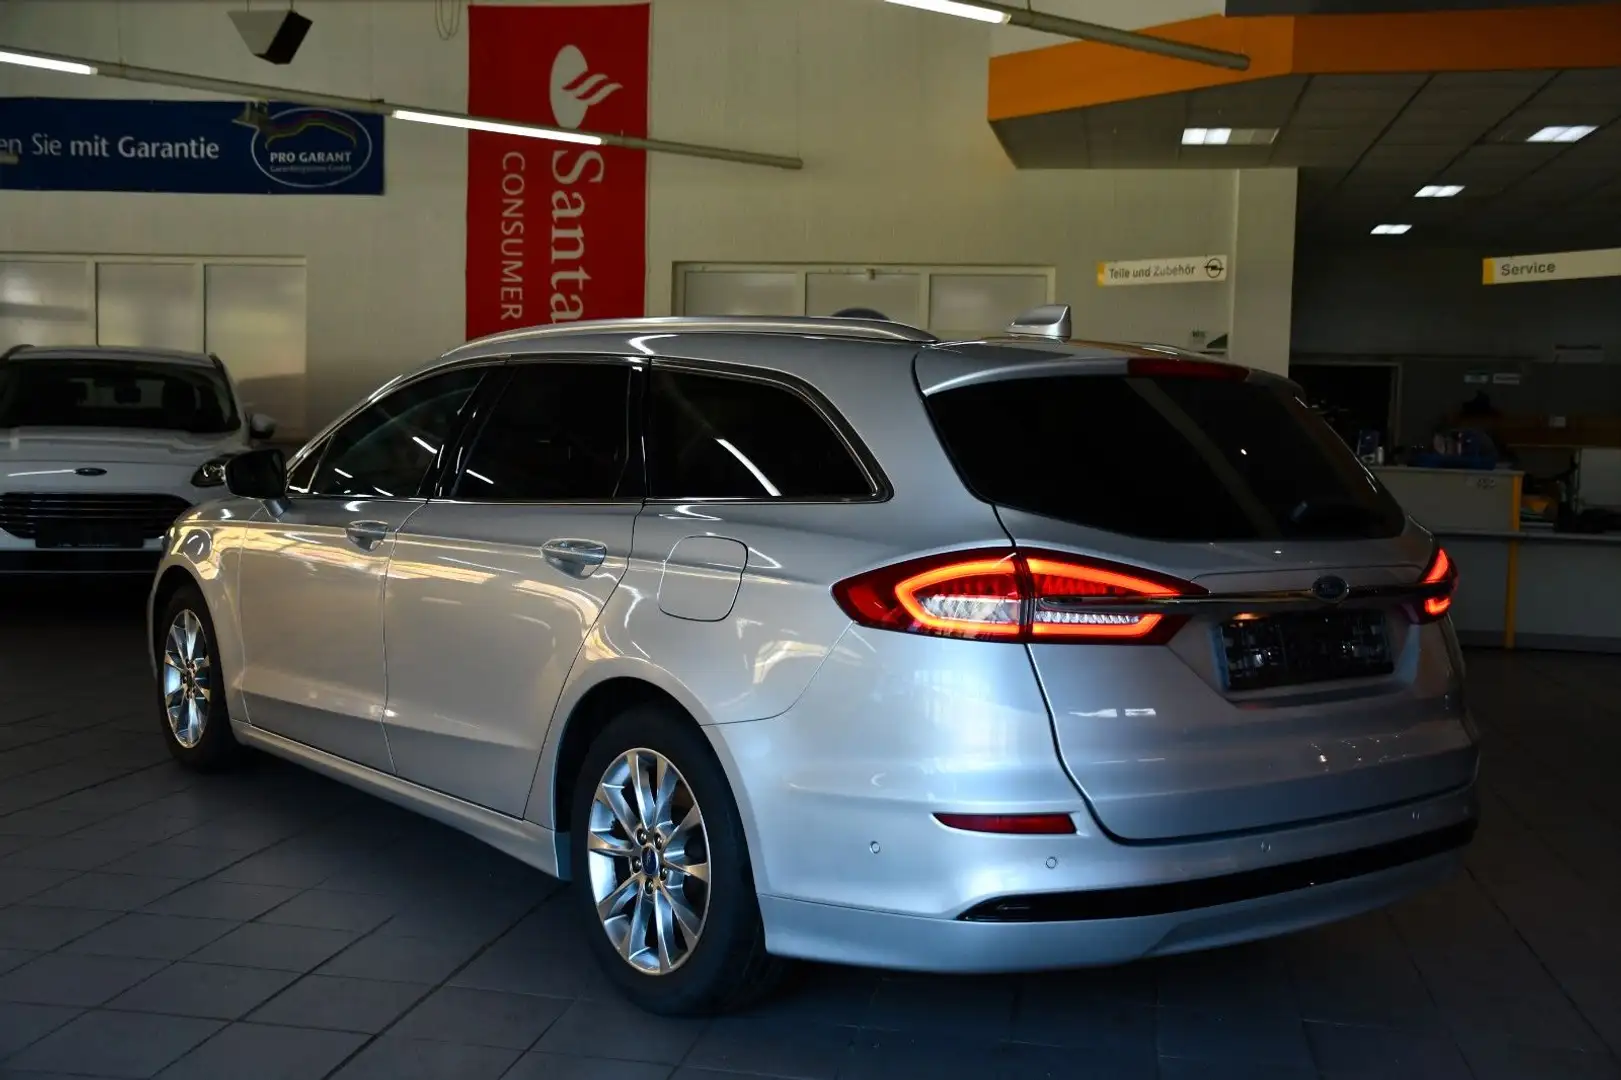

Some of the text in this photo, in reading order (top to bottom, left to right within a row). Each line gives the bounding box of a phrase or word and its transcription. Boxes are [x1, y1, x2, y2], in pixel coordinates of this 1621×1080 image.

[31, 132, 62, 156] Sie
[70, 134, 110, 158] mit
[118, 135, 220, 160] Garantie
[270, 151, 353, 163] PRO GARANT
[500, 151, 526, 321] CONSUMER
[1109, 263, 1196, 279] Teile und Zubehör
[1500, 261, 1556, 276] Service
